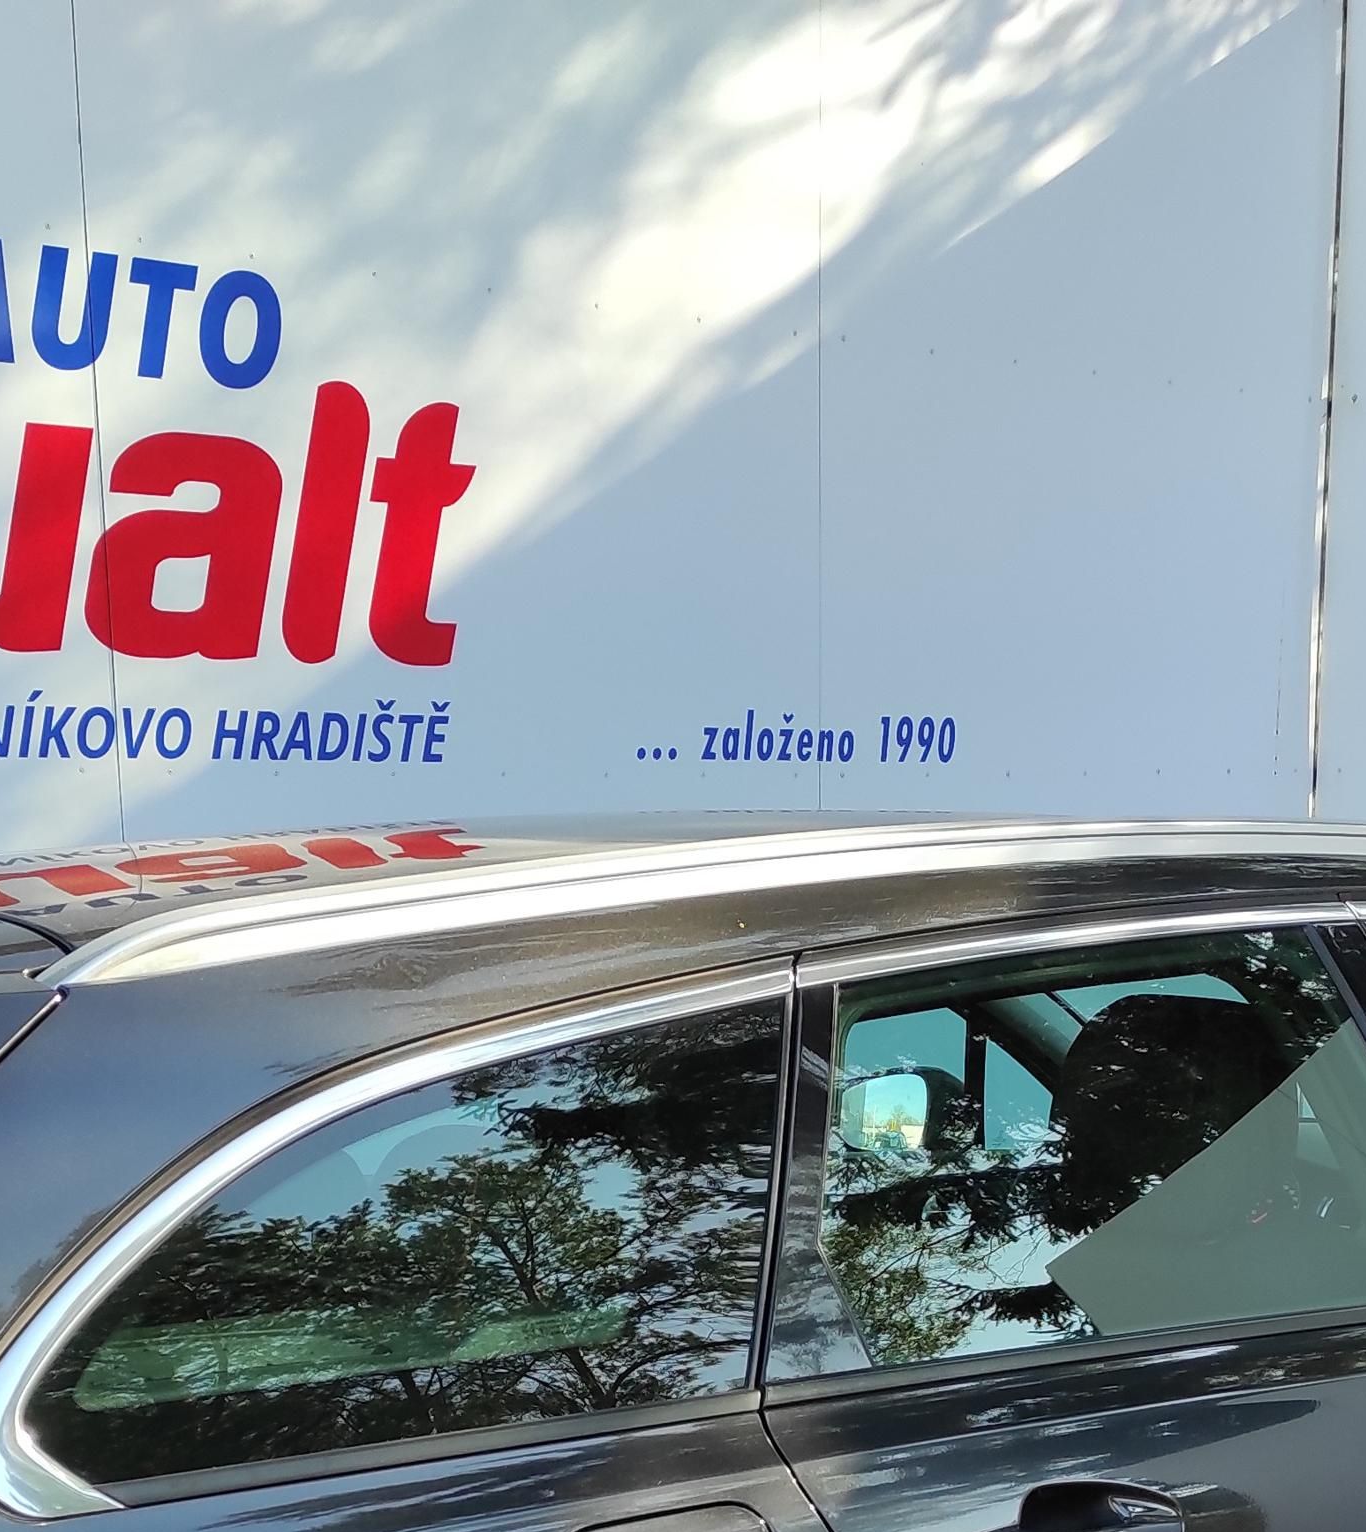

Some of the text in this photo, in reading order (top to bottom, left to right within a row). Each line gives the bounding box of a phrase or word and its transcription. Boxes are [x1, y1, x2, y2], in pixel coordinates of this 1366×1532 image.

[211, 698, 452, 764] HRADIŠTĚ
[700, 708, 855, 764] založeno
[879, 715, 957, 764] 1990
